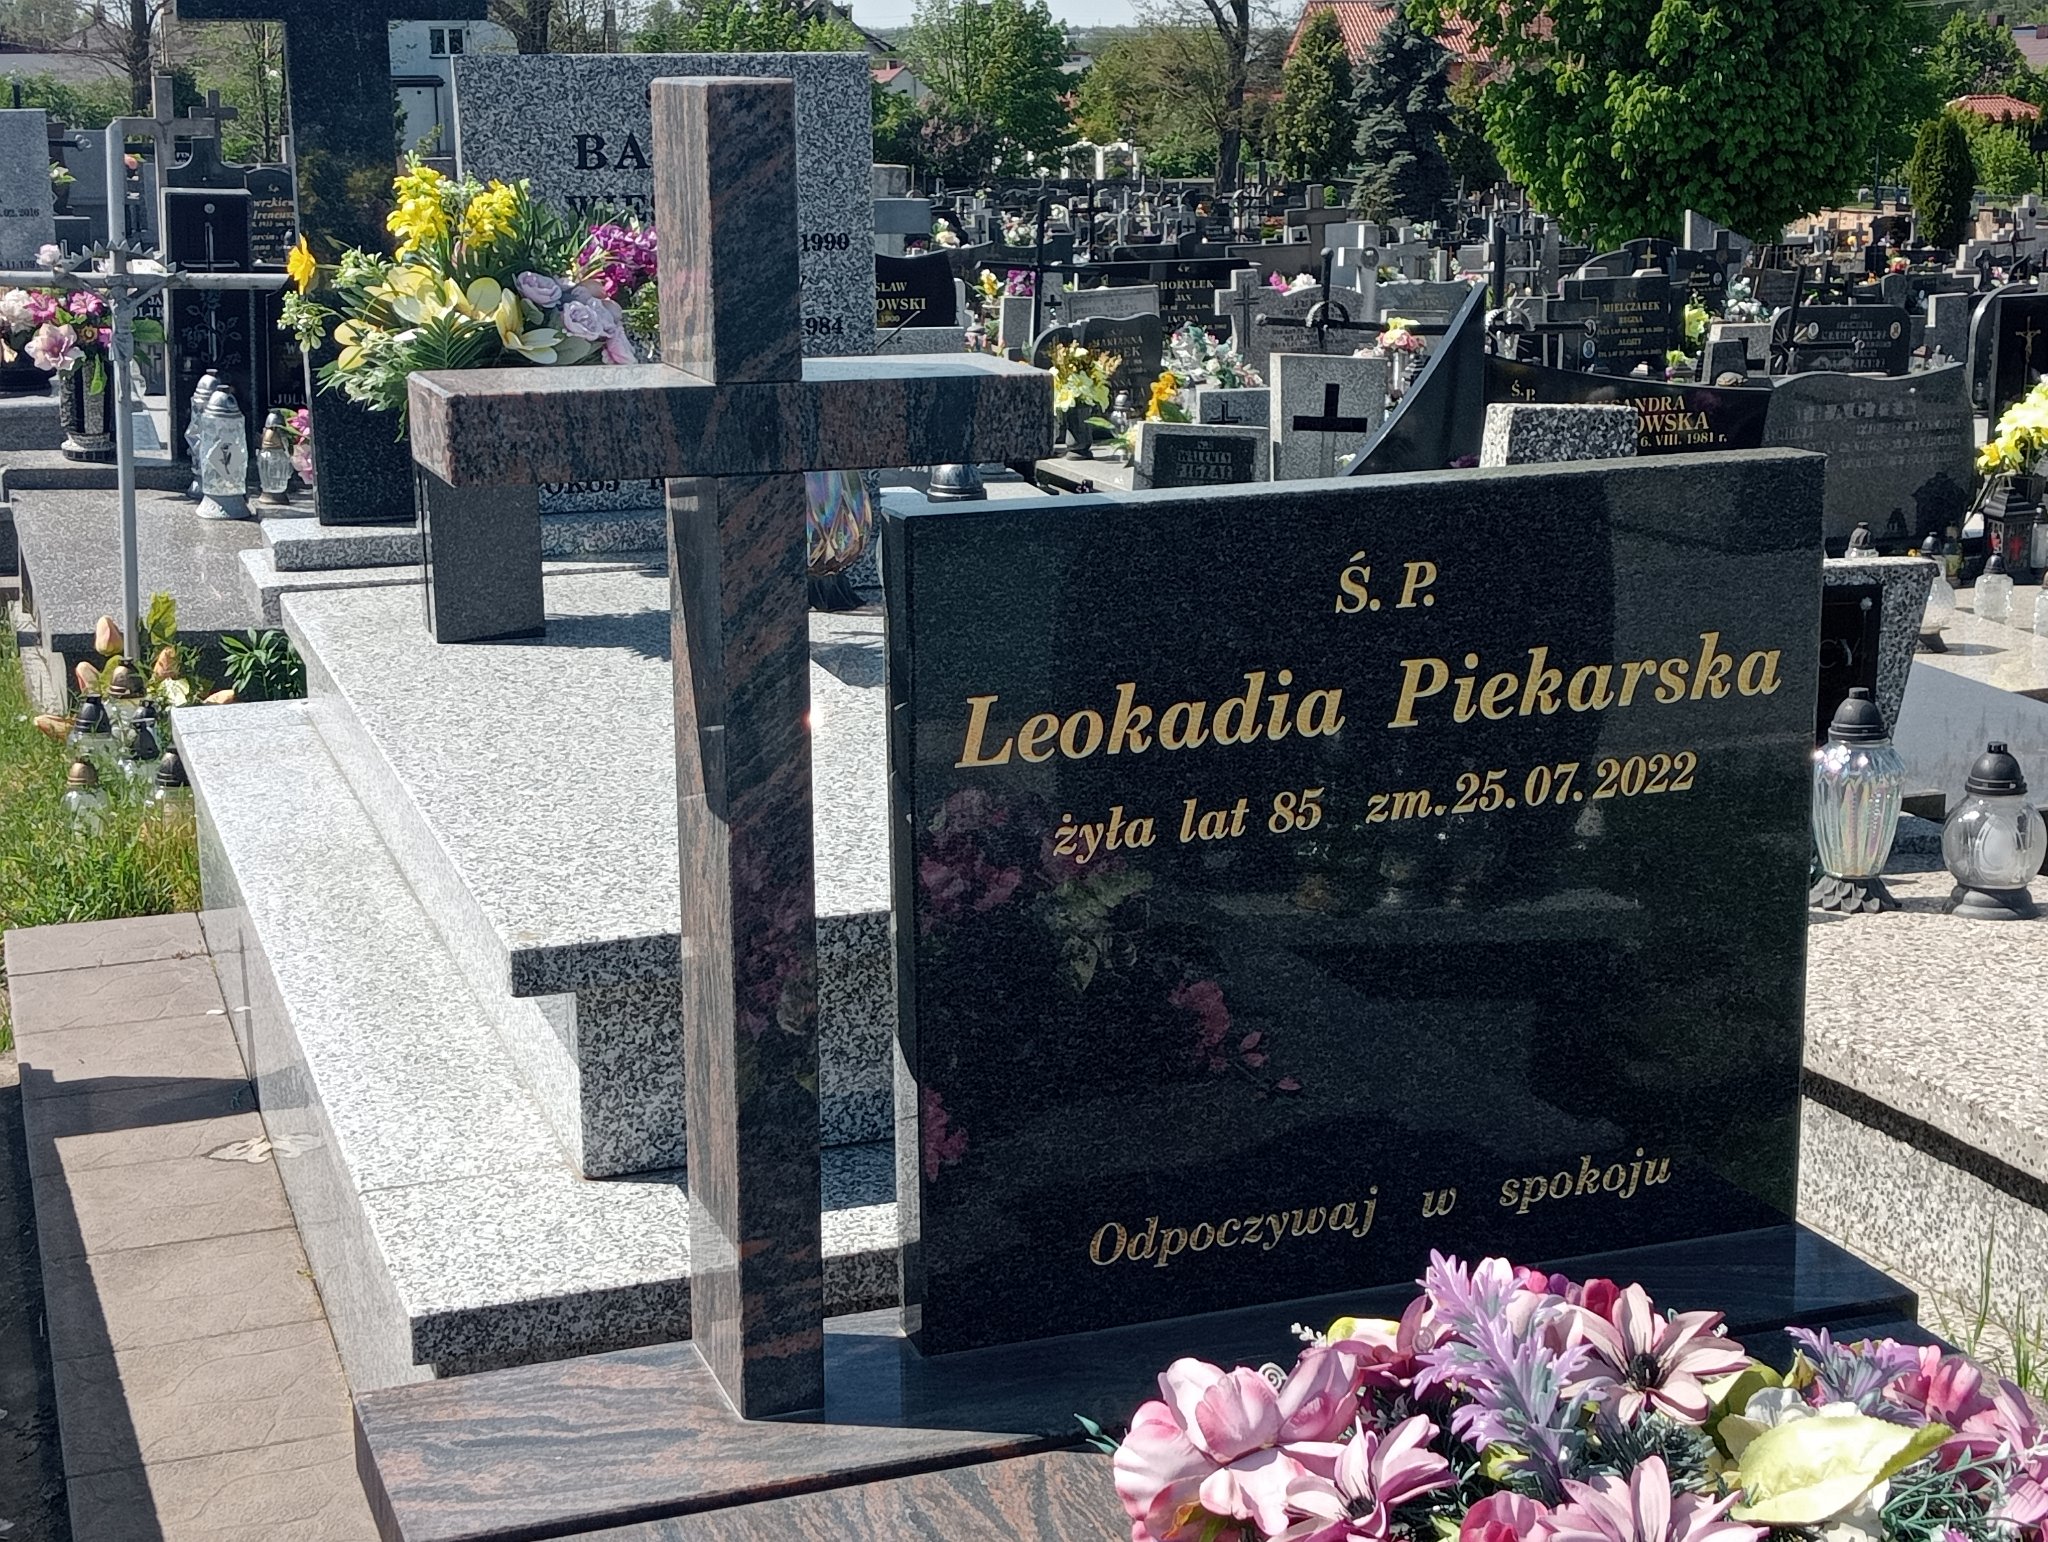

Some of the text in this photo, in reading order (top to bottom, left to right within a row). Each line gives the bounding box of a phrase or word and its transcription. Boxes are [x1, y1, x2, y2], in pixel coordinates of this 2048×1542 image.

[801, 232, 850, 251] 1990
[1687, 432, 1714, 445] 1981
[1335, 551, 1438, 615] Ś. P.
[954, 630, 1783, 770] Leokadia Piekarska
[1052, 804, 1157, 865] żyła
[1178, 797, 1251, 844] lat
[1267, 786, 1326, 834] 85
[1088, 1146, 1673, 1268] Odpoczywaj w spokoju
